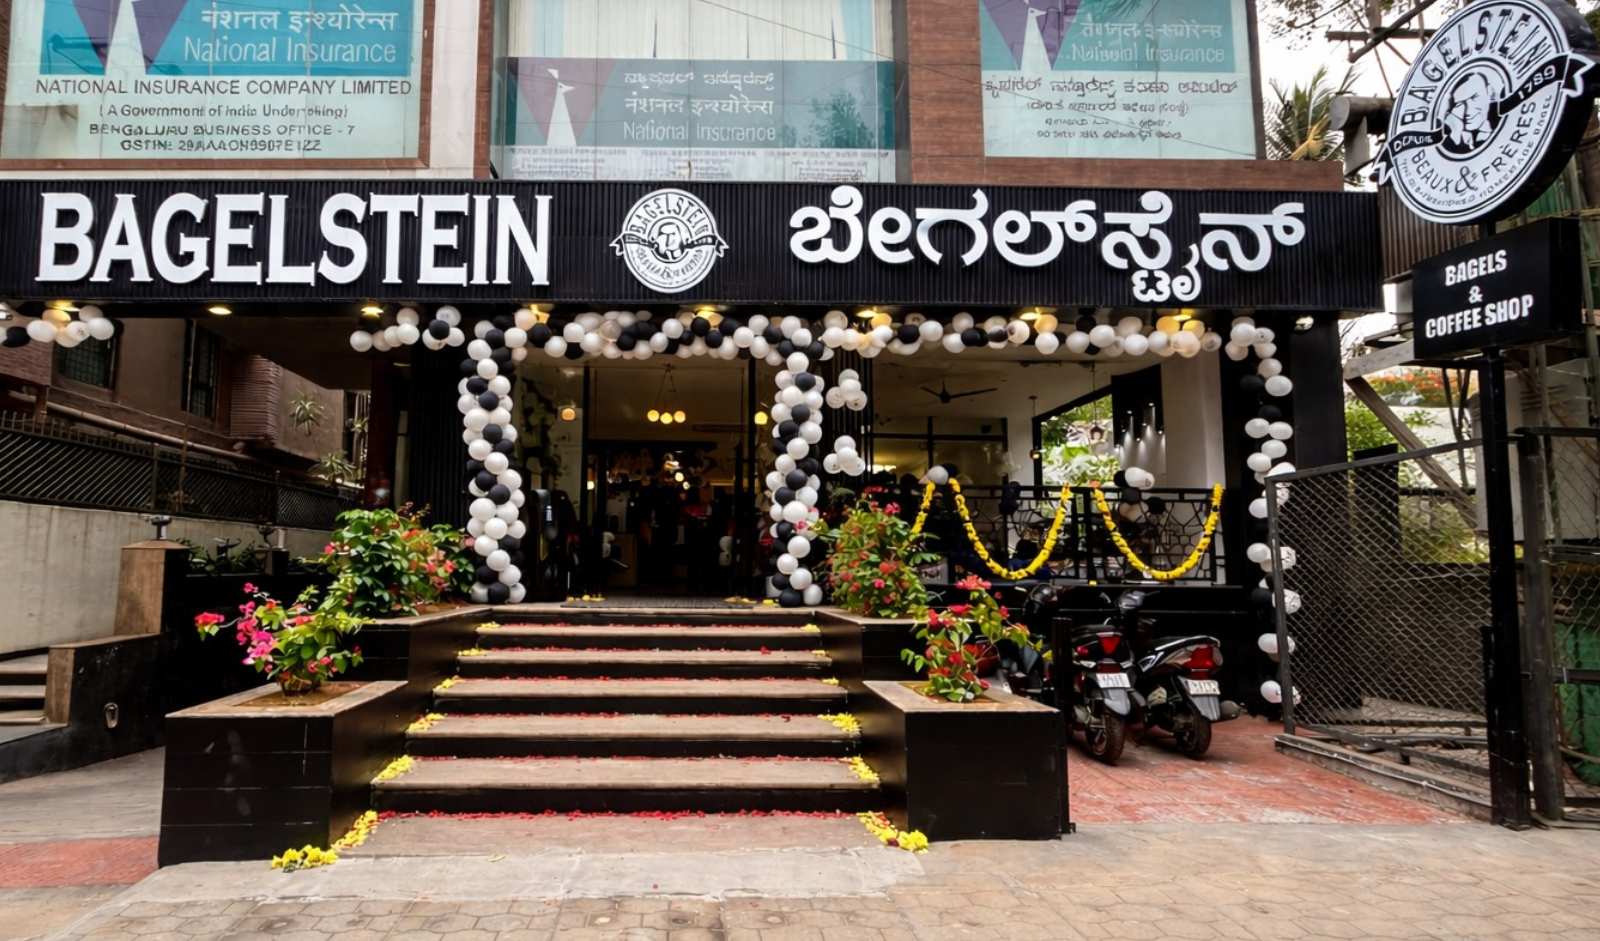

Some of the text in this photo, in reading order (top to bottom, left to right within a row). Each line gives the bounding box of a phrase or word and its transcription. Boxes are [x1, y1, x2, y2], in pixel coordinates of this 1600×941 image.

[184, 36, 396, 63] National Insurance
[1400, 8, 1553, 126] BAGELSTEIN
[36, 80, 412, 95] NATIONAL INSURANCE COMPANY LIMITED
[1518, 64, 1557, 100] 1789
[193, 124, 271, 136] BUSINESS
[276, 124, 332, 136] OFFICE
[623, 120, 776, 142] National Insurance
[1411, 148, 1455, 194] BEAUX
[1454, 165, 1479, 195] &
[35, 191, 553, 287] BAGELSTEIN
[1444, 249, 1508, 287] BAGELS
[1468, 285, 1483, 304] &
[1425, 294, 1534, 338] COFFEE SHOP
